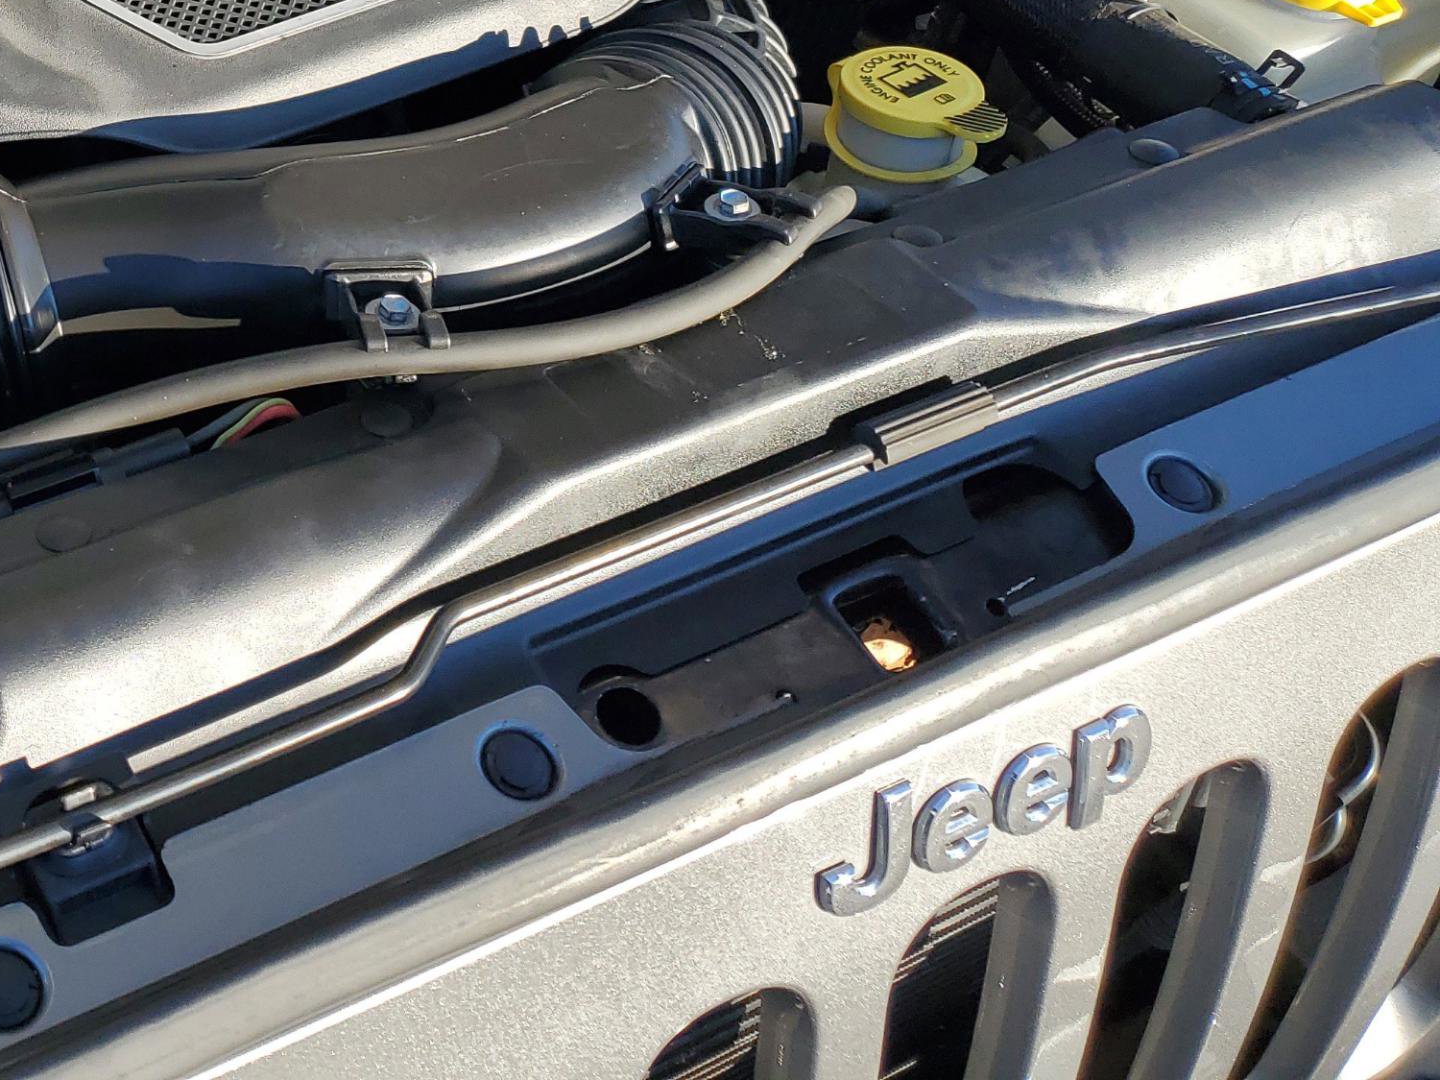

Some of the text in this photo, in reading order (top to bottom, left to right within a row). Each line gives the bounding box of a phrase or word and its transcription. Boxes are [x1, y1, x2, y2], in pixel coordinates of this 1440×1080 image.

[860, 53, 960, 103] ENGINE COOLANT ONLY
[814, 703, 1152, 916] Jeep
